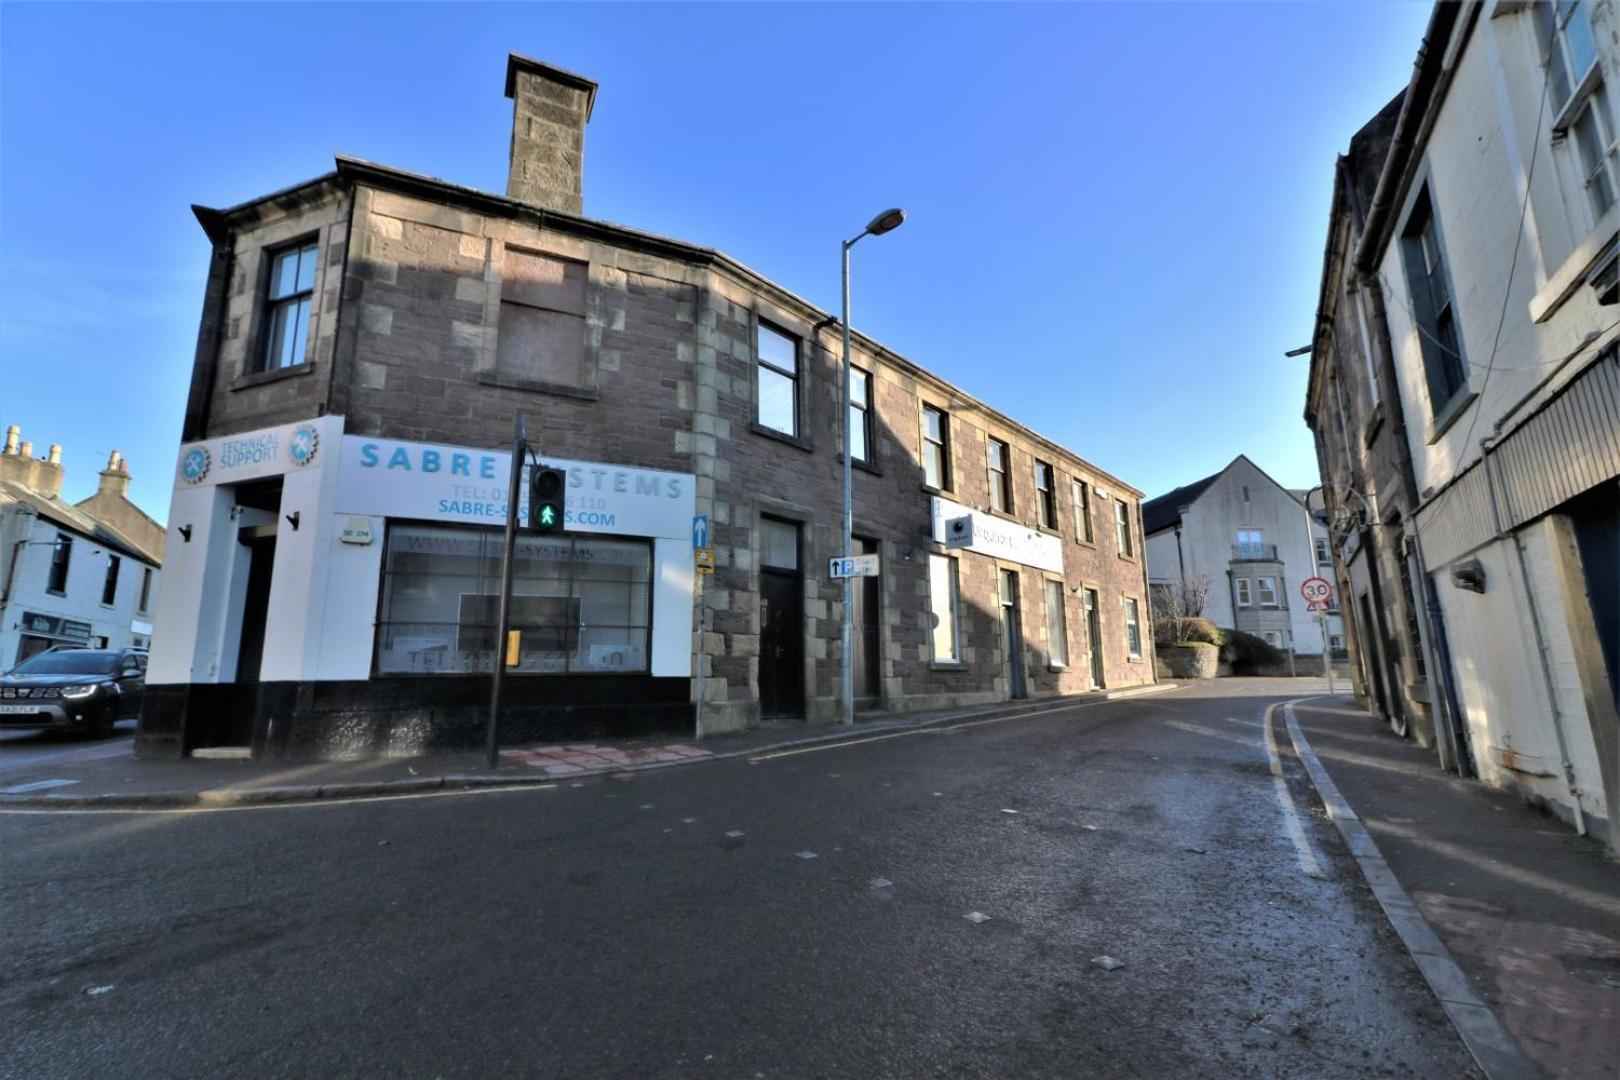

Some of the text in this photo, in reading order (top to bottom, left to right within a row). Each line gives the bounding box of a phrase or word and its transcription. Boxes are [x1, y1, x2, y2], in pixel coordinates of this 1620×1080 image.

[223, 434, 279, 454] TECHNICAL
[219, 447, 279, 469] SUPPORT
[360, 443, 683, 499] SABRE SSTEMS
[451, 485, 486, 500] TEL:
[1306, 585, 1327, 596] 30
